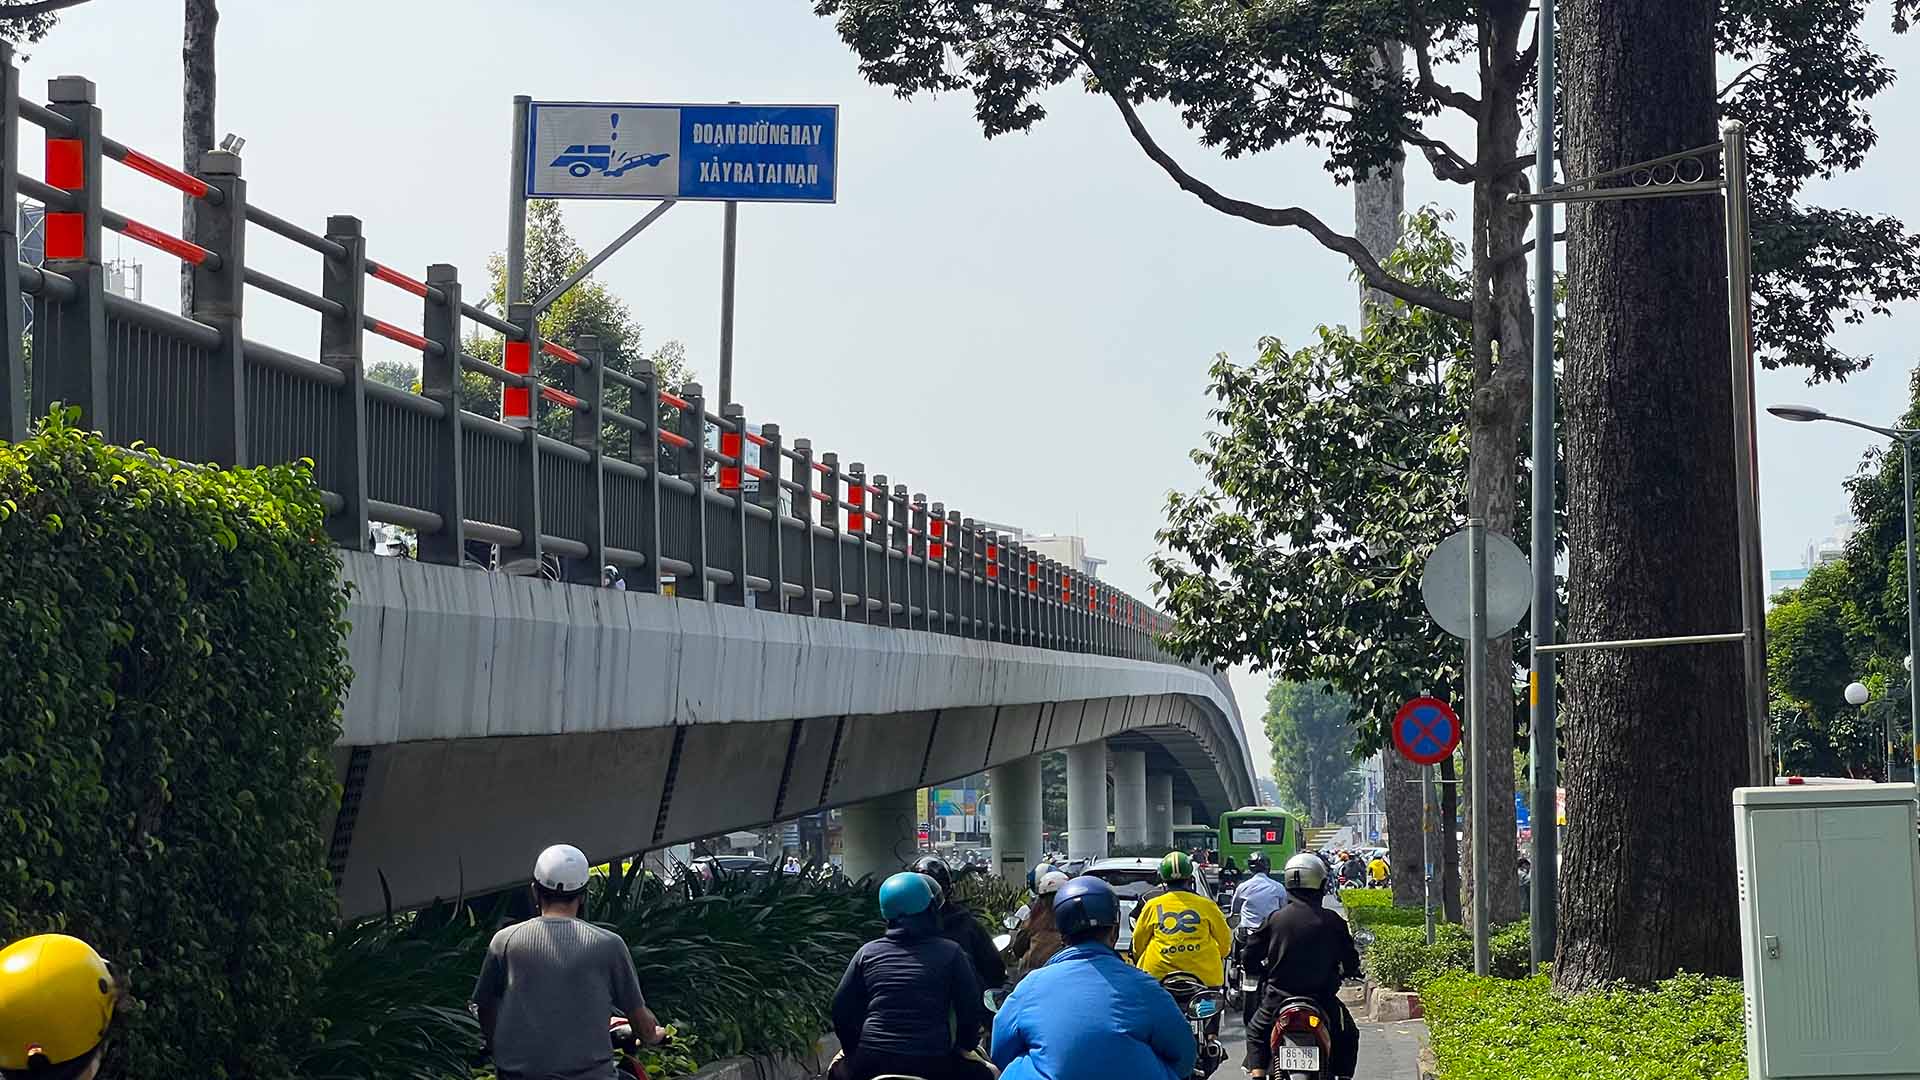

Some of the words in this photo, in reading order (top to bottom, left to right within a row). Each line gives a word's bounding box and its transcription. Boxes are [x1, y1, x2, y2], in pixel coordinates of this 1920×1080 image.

[693, 123, 736, 147] ĐOẠN
[738, 119, 790, 145] ĐƯỜNG
[791, 125, 822, 145] HAY
[699, 155, 732, 182] XẢY
[733, 162, 754, 183] RA
[757, 163, 782, 184] TAI
[785, 163, 818, 188] NẠN
[1157, 904, 1200, 935] be
[1286, 1059, 1313, 1069] 0132
